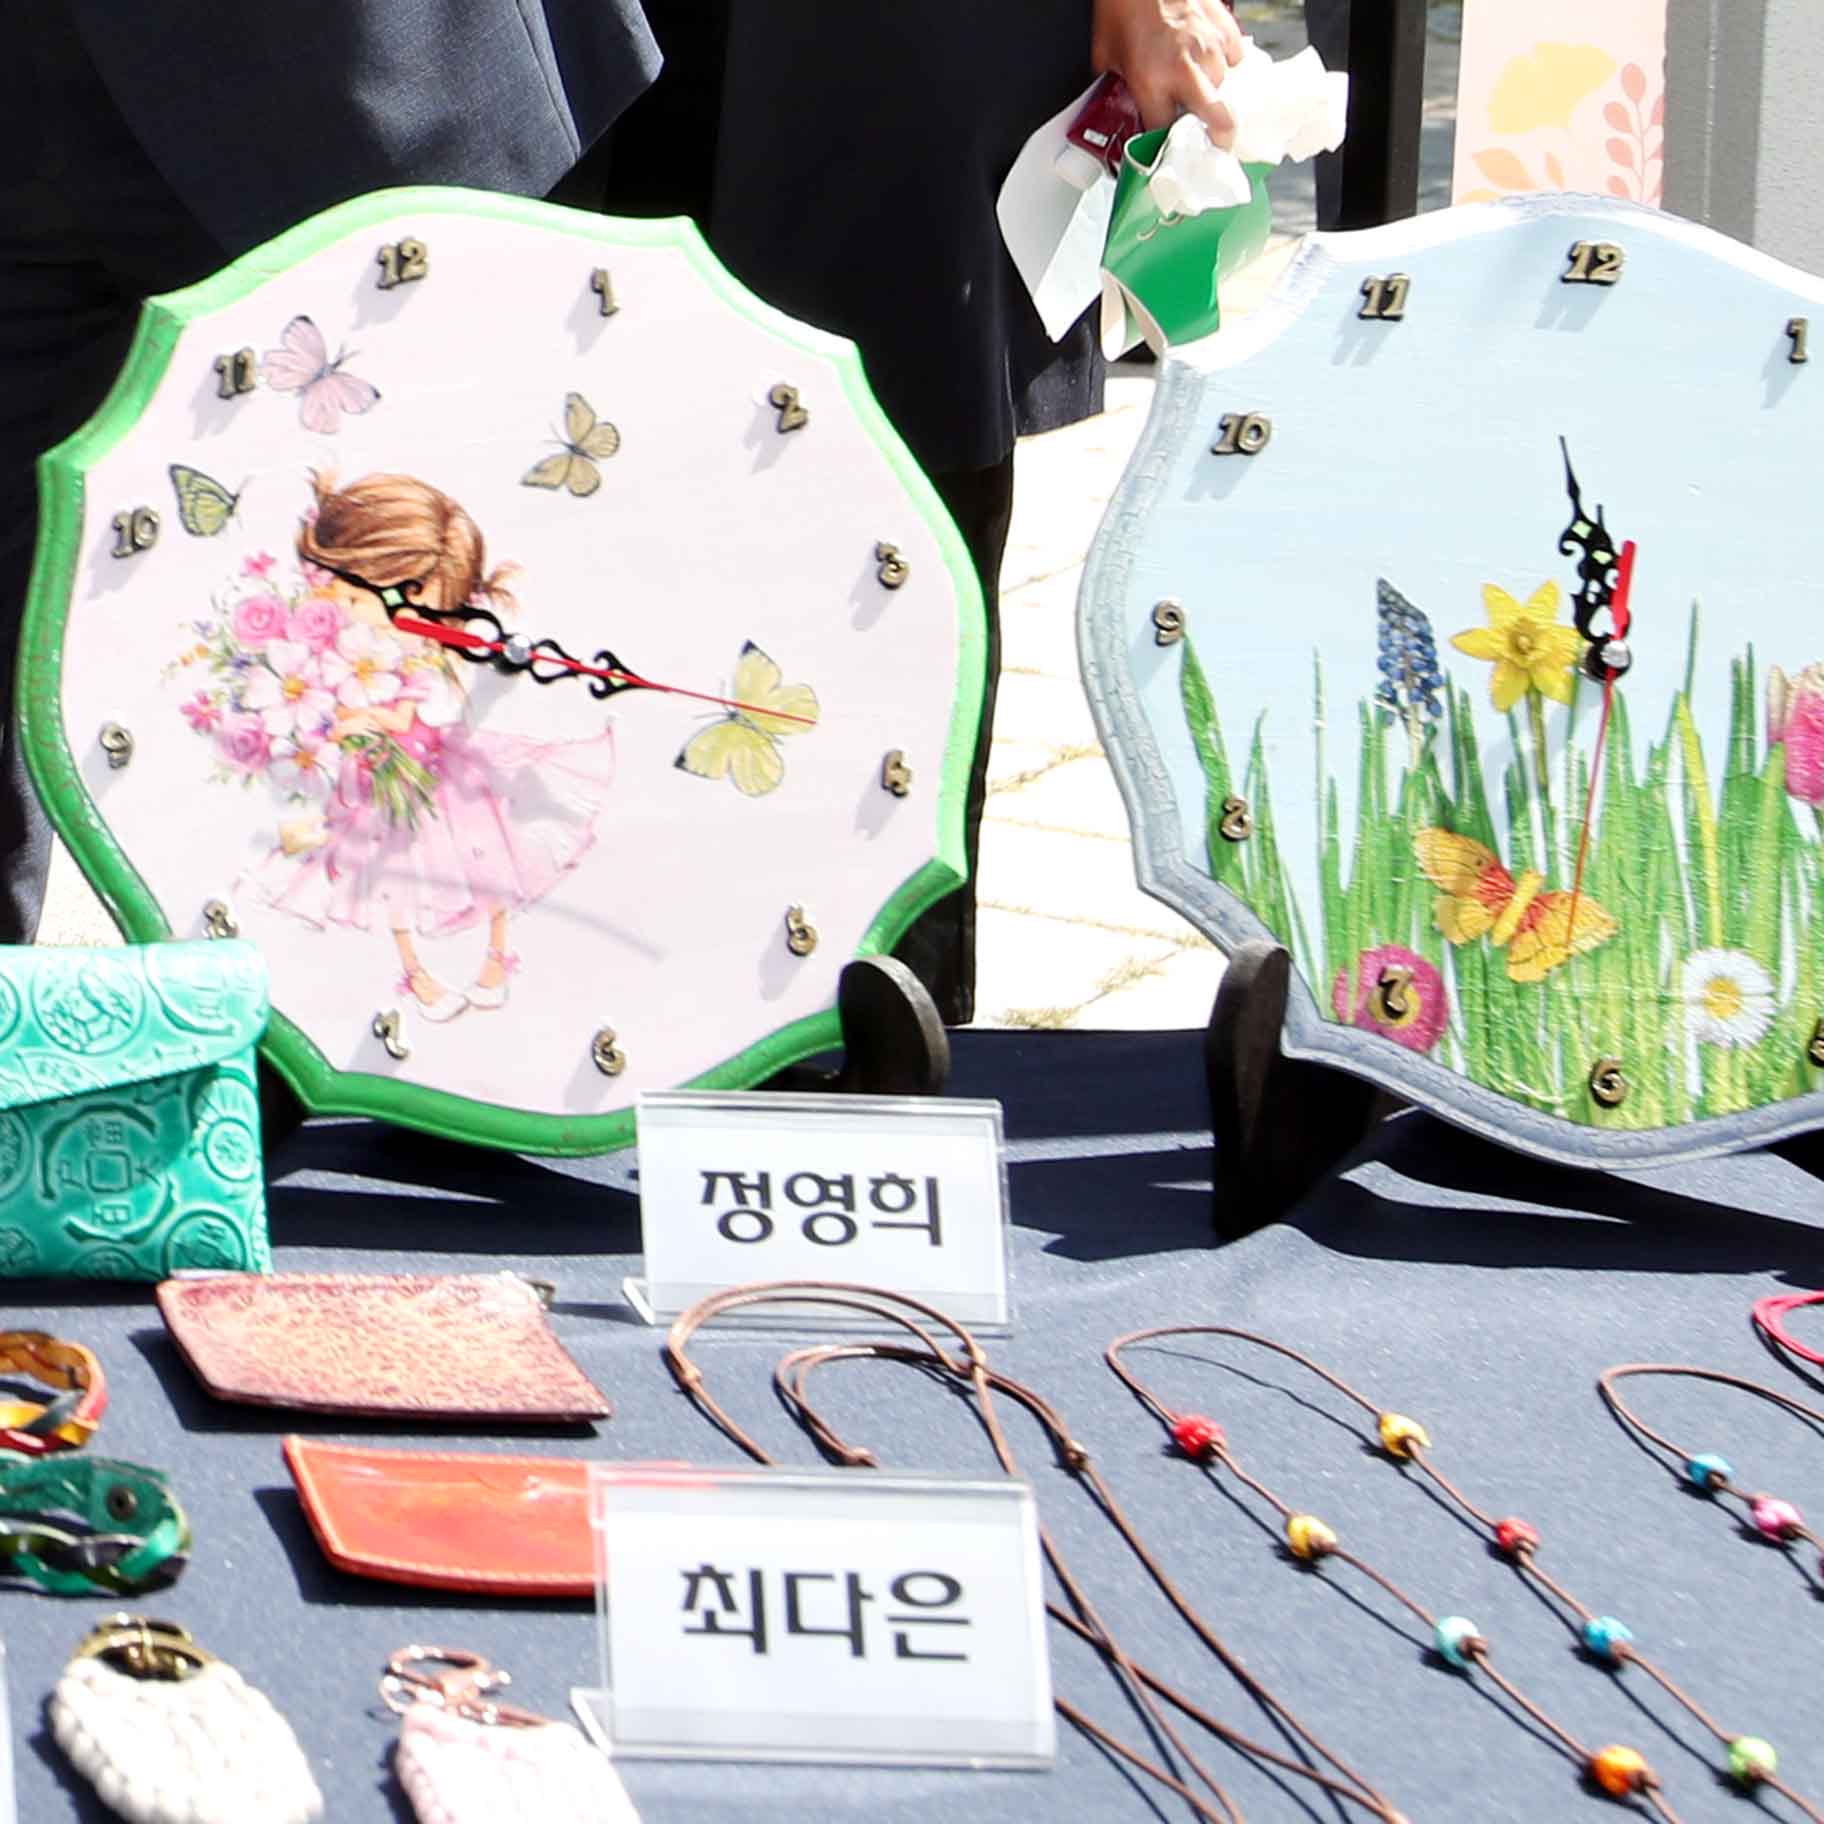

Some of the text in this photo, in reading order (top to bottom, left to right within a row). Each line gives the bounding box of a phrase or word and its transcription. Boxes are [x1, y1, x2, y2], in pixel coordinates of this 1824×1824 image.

[374, 236, 431, 291] 12
[1560, 240, 1624, 285] 12
[589, 266, 619, 318] 1
[1358, 273, 1410, 321] 11
[1785, 317, 1810, 365] 1
[213, 346, 260, 398] 11
[769, 383, 809, 434] 2
[1212, 412, 1272, 456] 10
[111, 504, 161, 559] 10
[874, 540, 912, 591] 3
[1152, 598, 1186, 646] 9
[99, 722, 135, 769] 9
[881, 749, 916, 799] 4
[1218, 795, 1254, 842] 8
[783, 905, 819, 957] 5
[1377, 965, 1415, 1018] 7
[372, 1007, 411, 1059] 7
[592, 1027, 627, 1077] 6
[1588, 1057, 1630, 1107] 6
[700, 1168, 944, 1247] 정영희
[679, 1560, 974, 1665] 최다은
